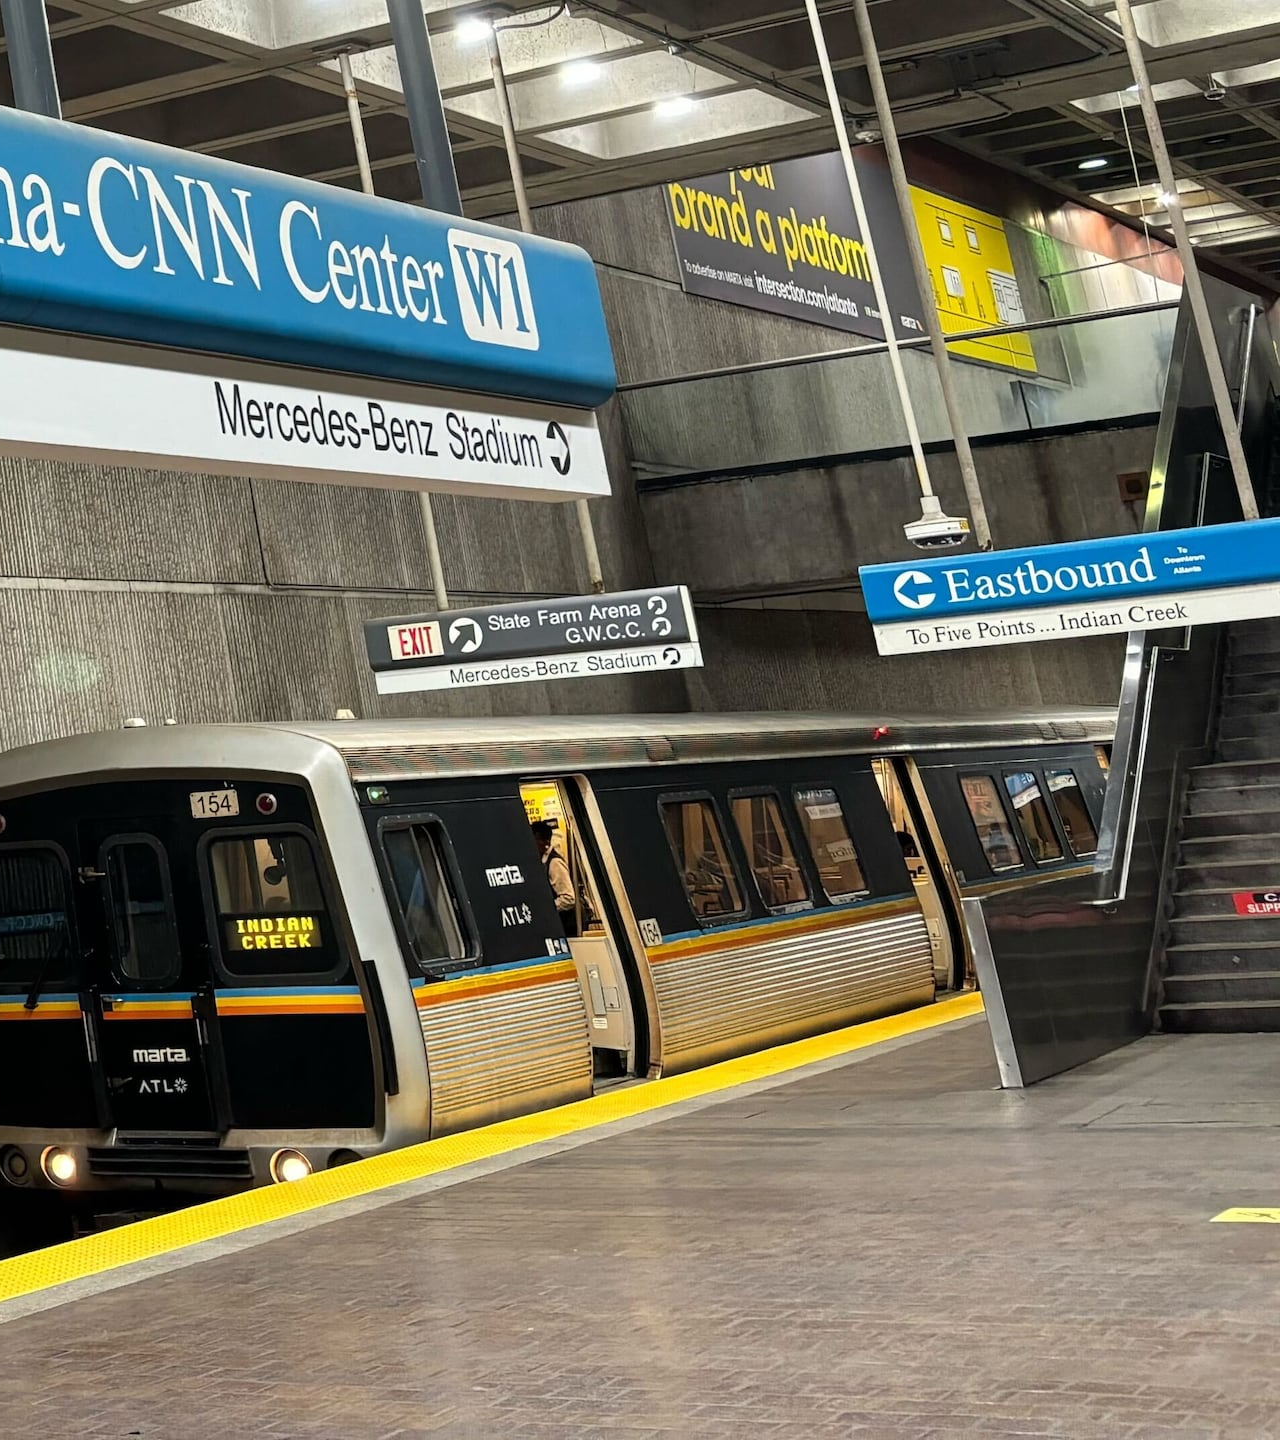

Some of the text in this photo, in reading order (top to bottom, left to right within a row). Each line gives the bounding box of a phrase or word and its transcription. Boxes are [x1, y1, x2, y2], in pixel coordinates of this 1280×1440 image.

[668, 183, 872, 282] brand a platform
[278, 201, 447, 326] Center
[453, 241, 533, 337] W1
[754, 270, 859, 317] intersection.com/atlanta
[214, 381, 543, 469] Mercedes-Benz Stadium
[941, 547, 1157, 603] Eastbound
[488, 603, 641, 631] State Farm Arena
[906, 627, 930, 645] To
[935, 624, 972, 643] Five
[978, 620, 1036, 639] Points
[1059, 611, 1122, 631] Indian
[1128, 603, 1188, 623] Creek
[398, 625, 434, 657] EXIT
[566, 623, 646, 644] G.W.C.C.
[449, 652, 657, 684] Mercedes-Benz Stadium
[197, 794, 232, 814] 154
[236, 917, 314, 934] INDIAN
[643, 921, 660, 944] 154
[241, 933, 312, 950] CREEK
[133, 1047, 187, 1063] marta
[139, 1079, 174, 1093] ATL
